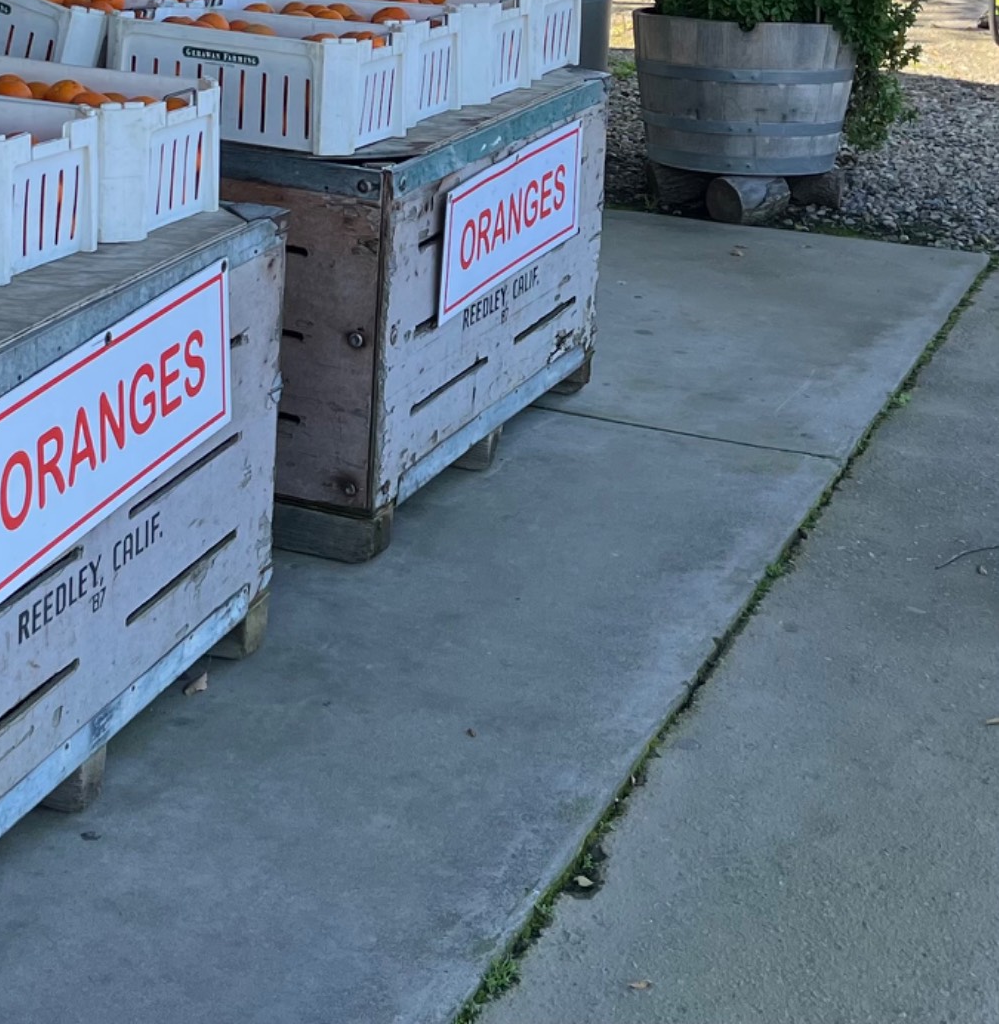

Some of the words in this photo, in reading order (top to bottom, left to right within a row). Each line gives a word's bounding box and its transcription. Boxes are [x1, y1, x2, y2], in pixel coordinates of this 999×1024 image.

[460, 164, 566, 270] ORANGES
[512, 265, 540, 300] CALIF.
[0, 329, 206, 531] ORANGES
[18, 554, 104, 645] REEDLEY,
[113, 511, 163, 572] CALIF.
